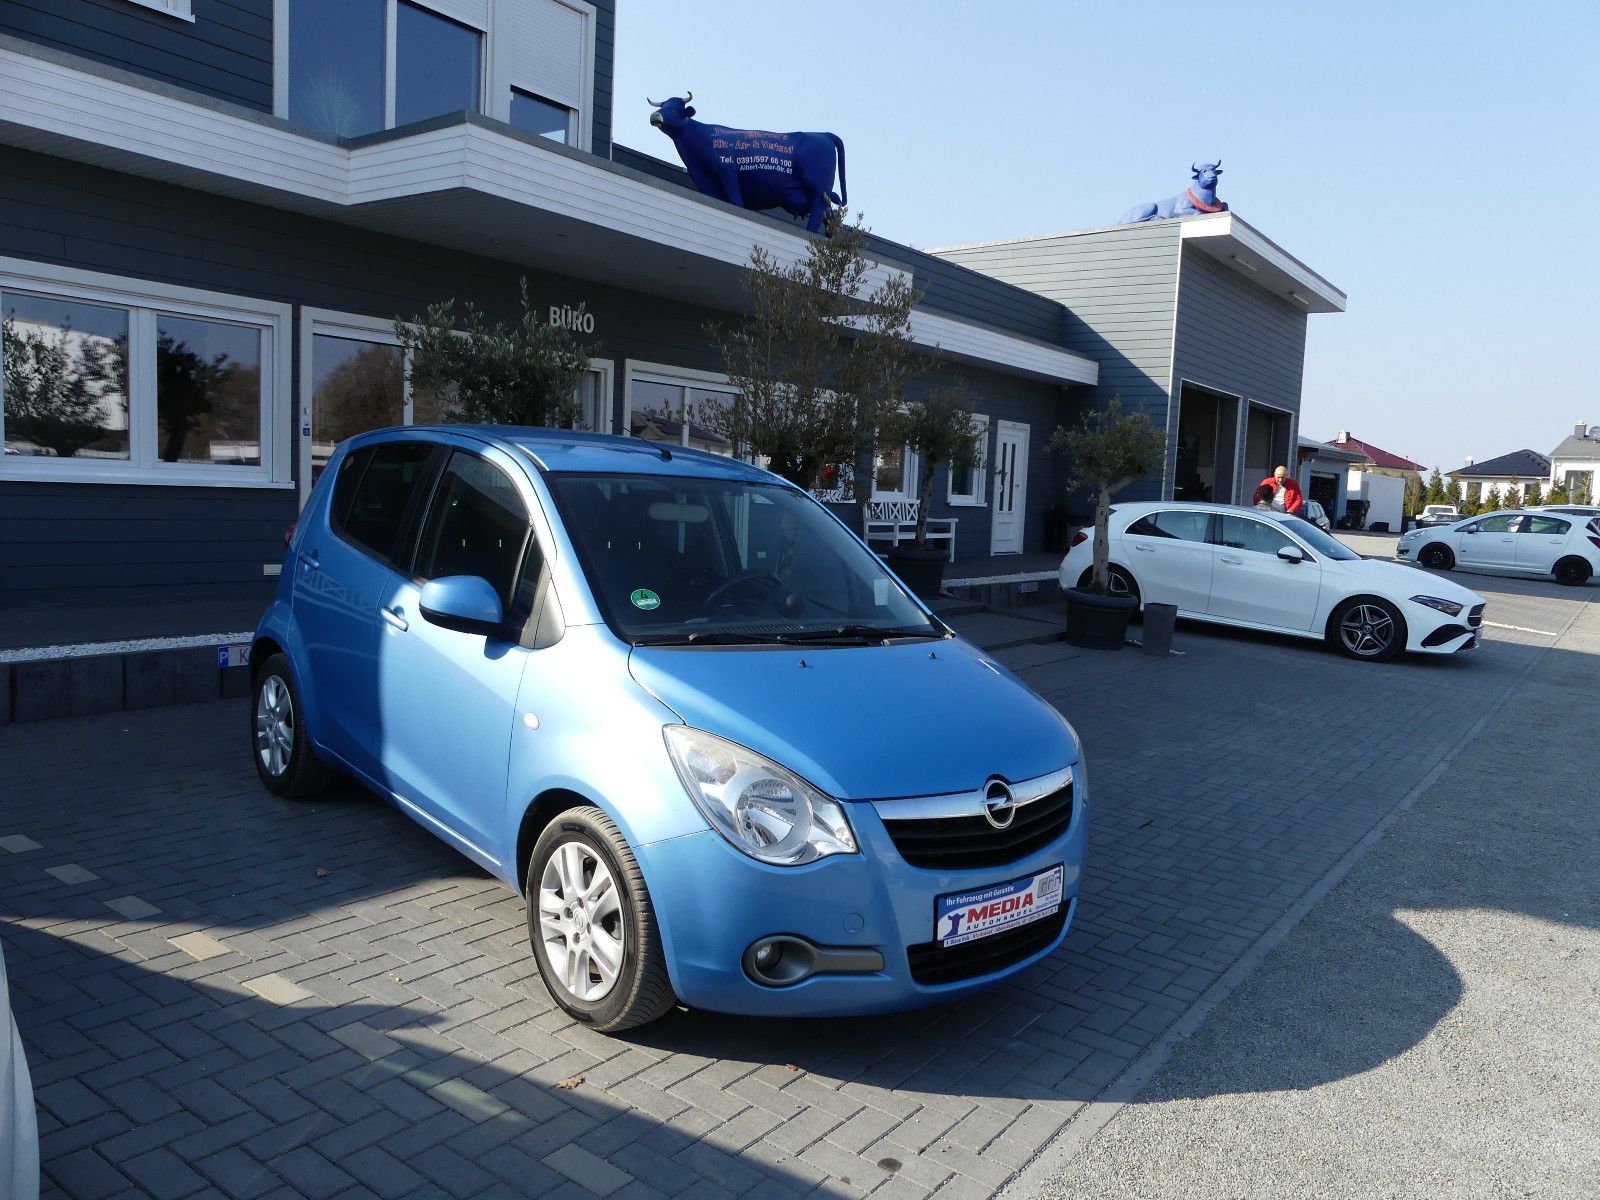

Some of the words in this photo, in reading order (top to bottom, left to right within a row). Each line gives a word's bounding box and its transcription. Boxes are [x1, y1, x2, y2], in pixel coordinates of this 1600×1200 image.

[720, 156, 734, 164] Tel.
[736, 155, 769, 165] 0391/597
[780, 159, 792, 168] 100
[549, 304, 595, 334] BÜRO
[220, 651, 228, 664] P
[946, 897, 956, 906] Ihr
[956, 892, 983, 904] Fahrzeug
[983, 890, 993, 899] mit
[993, 884, 1015, 897] Garantie
[966, 907, 1033, 931] AUTOHANDEL
[967, 892, 1034, 924] MEDIA
